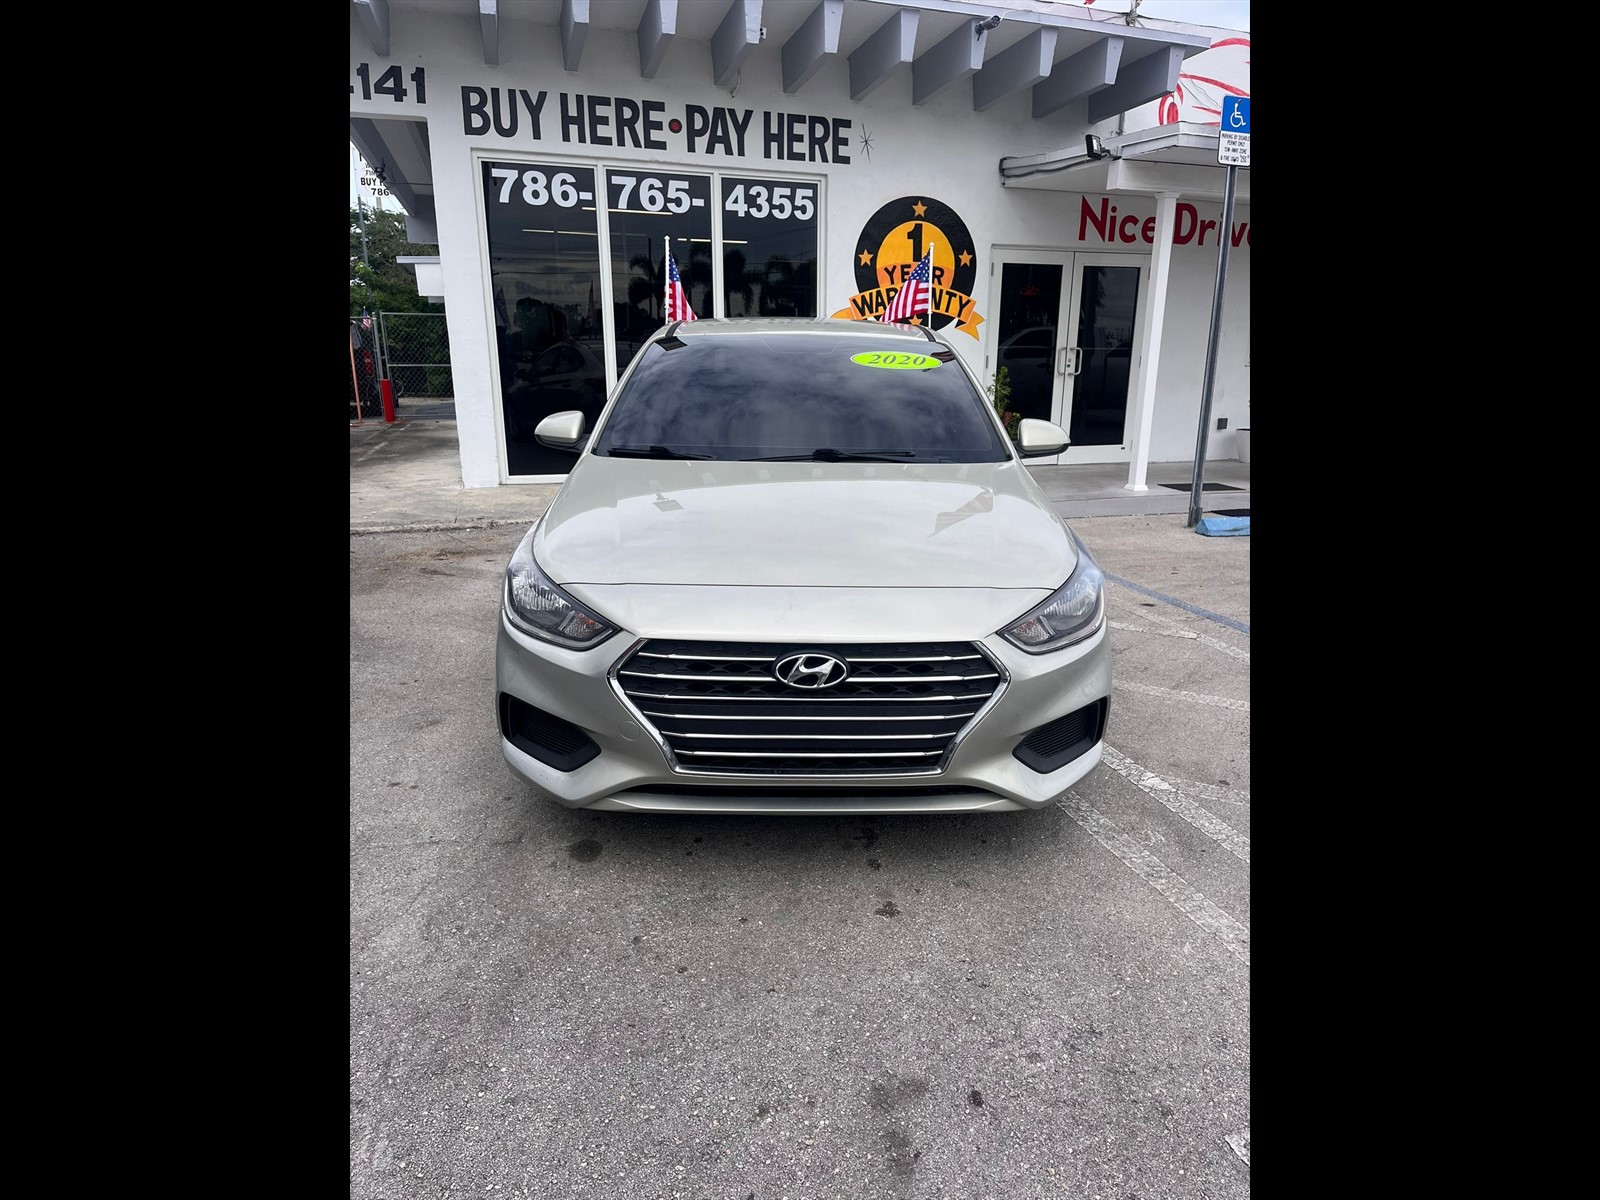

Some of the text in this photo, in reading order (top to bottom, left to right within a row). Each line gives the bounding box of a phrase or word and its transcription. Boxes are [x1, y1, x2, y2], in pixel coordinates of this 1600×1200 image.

[350, 62, 426, 104] 141
[461, 85, 852, 165] BUY HERE PAY HERE
[360, 177, 377, 186] BUY
[491, 167, 815, 221] 786- 765- 4355
[1078, 194, 1250, 248] Nice Drv
[907, 223, 923, 263] 1
[884, 264, 945, 286] YER
[852, 287, 971, 319] WARNTY
[868, 354, 927, 366] 2020
